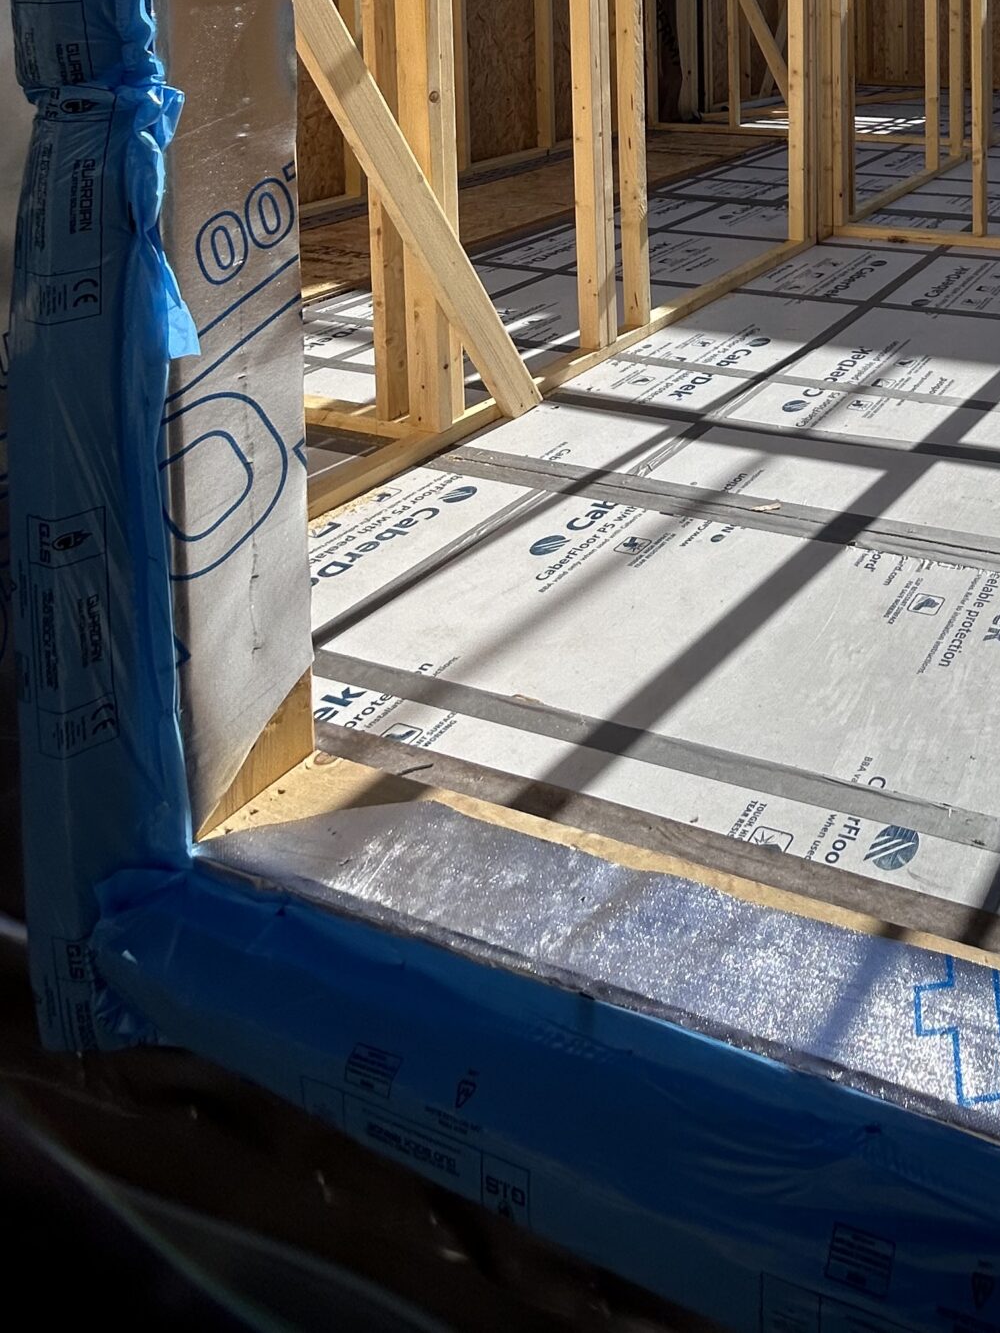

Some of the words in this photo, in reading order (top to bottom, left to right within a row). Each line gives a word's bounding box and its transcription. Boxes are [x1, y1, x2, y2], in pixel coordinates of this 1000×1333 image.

[79, 159, 96, 231] GUARDIAN
[924, 266, 971, 298] CaberDek
[668, 349, 752, 401] CabrDek
[356, 515, 392, 534] with
[390, 504, 410, 514] P5
[38, 523, 52, 563] G.I.S
[533, 533, 601, 581] CaberFloor
[597, 521, 615, 534] P5
[937, 606, 982, 668] protection
[422, 719, 458, 748] WORKING
[857, 756, 873, 772] BBA
[816, 814, 837, 840] when
